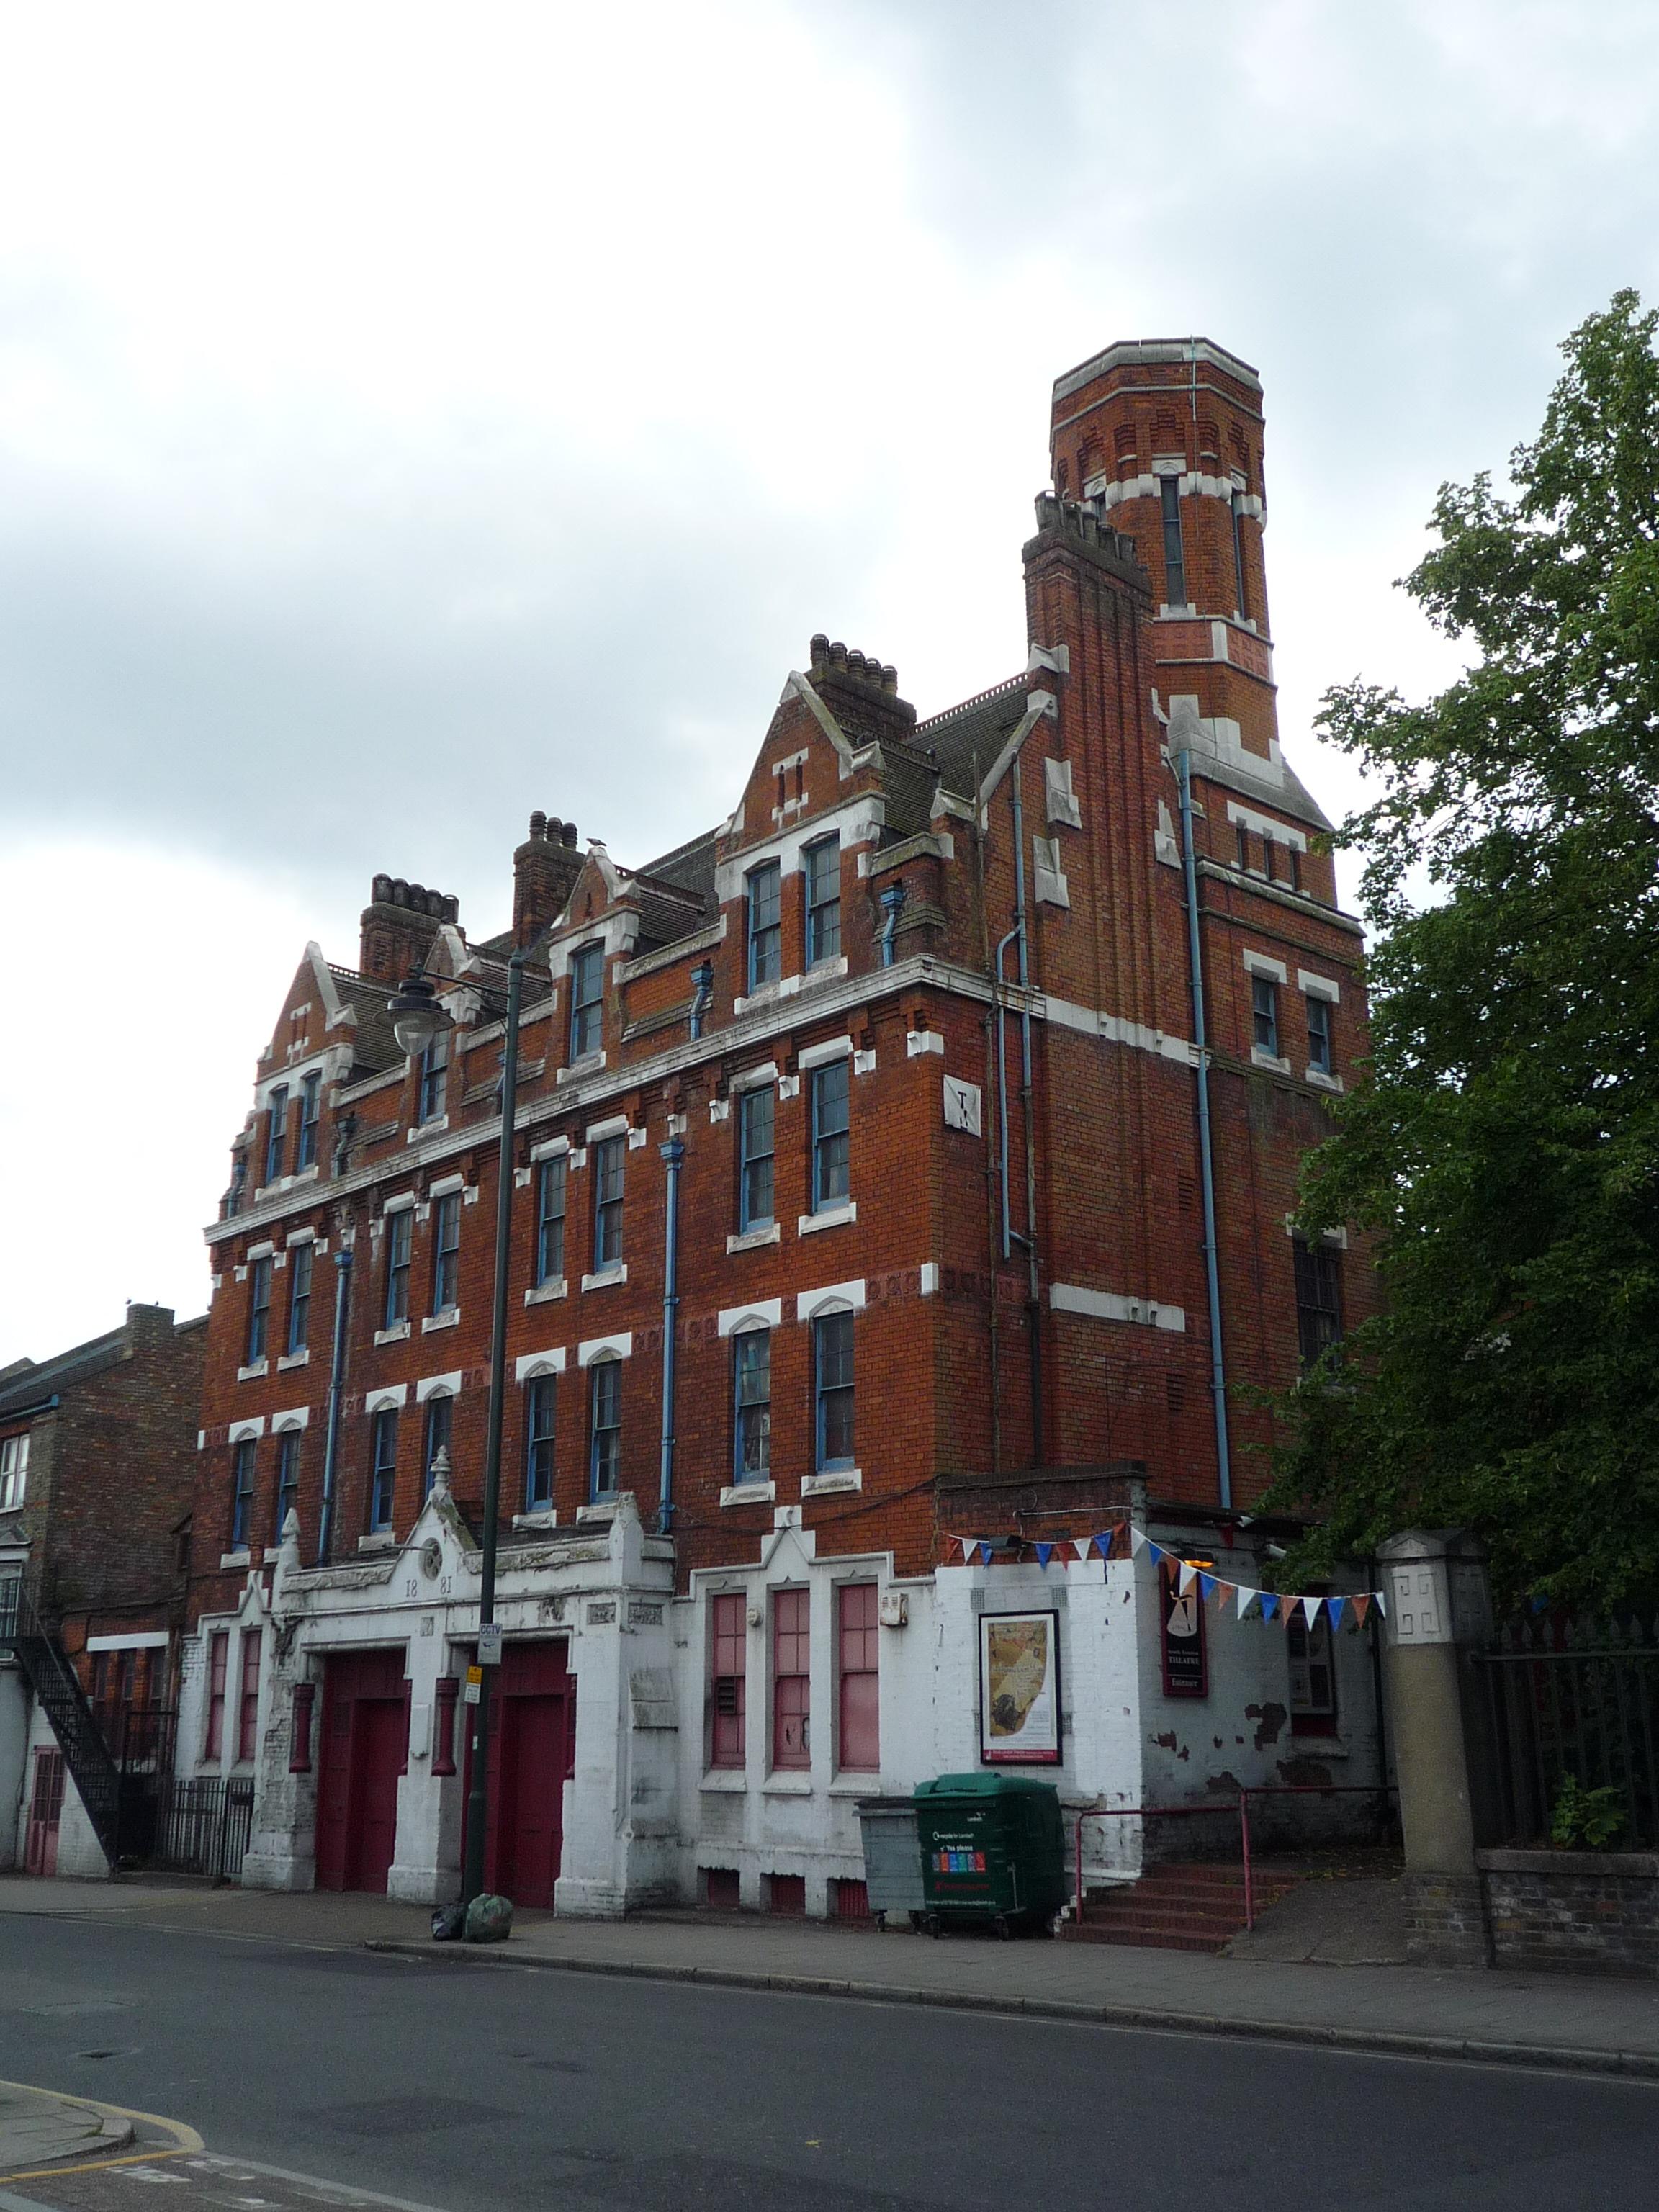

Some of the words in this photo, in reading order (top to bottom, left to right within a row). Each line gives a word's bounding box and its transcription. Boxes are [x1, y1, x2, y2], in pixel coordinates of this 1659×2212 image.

[480, 1624, 501, 1635] CCTV
[1169, 1656, 1200, 1665] THEATRE
[956, 1843, 974, 1852] please
